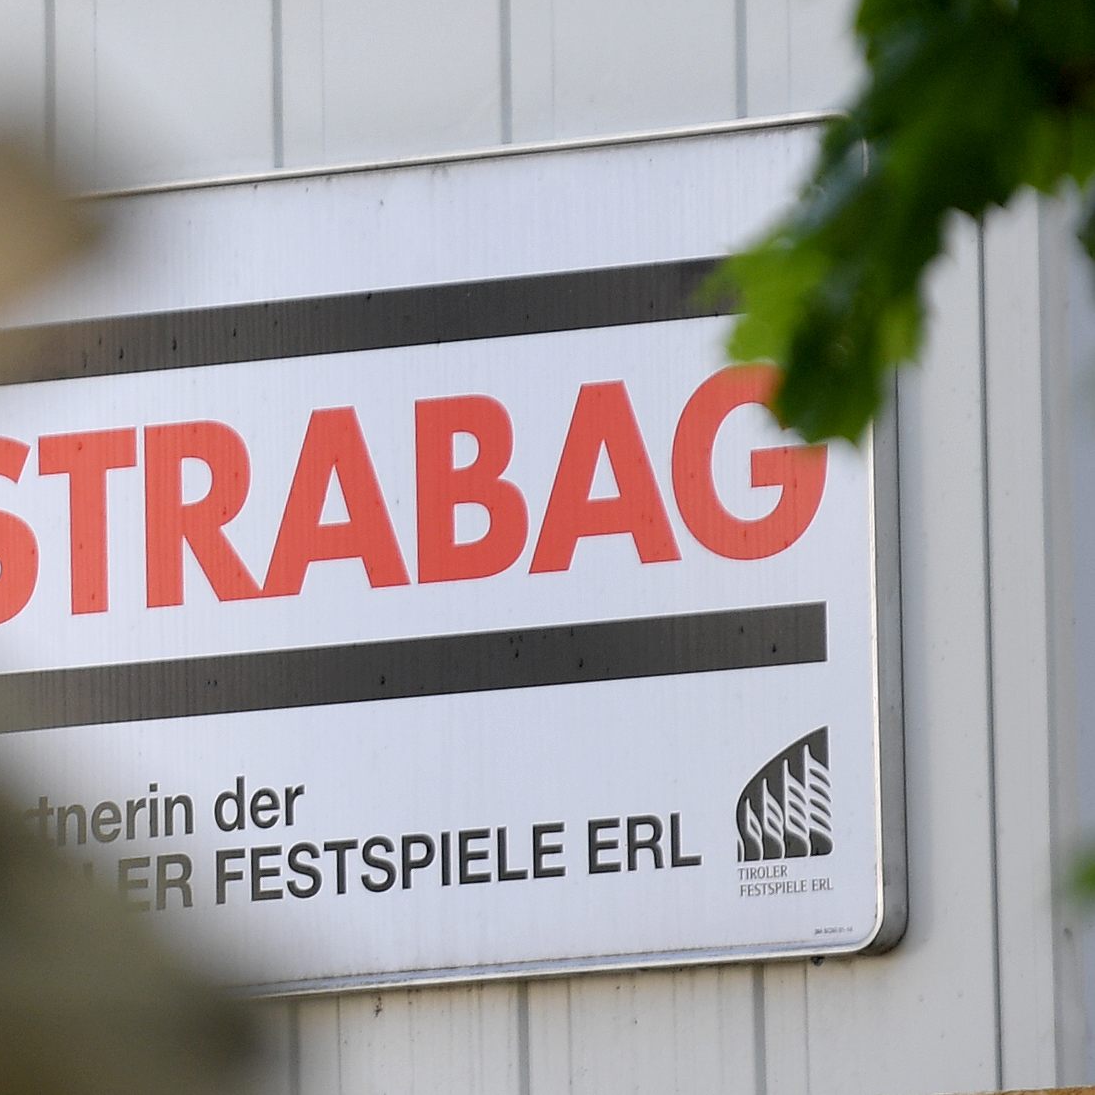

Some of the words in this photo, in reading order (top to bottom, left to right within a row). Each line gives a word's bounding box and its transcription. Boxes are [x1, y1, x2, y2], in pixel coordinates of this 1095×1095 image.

[214, 775, 306, 832] der
[215, 821, 566, 905] FESTSPIELE
[587, 812, 702, 874] ERL
[738, 865, 788, 881] TIROLER
[740, 881, 807, 897] FESTSPIELE
[812, 879, 834, 892] ERL
